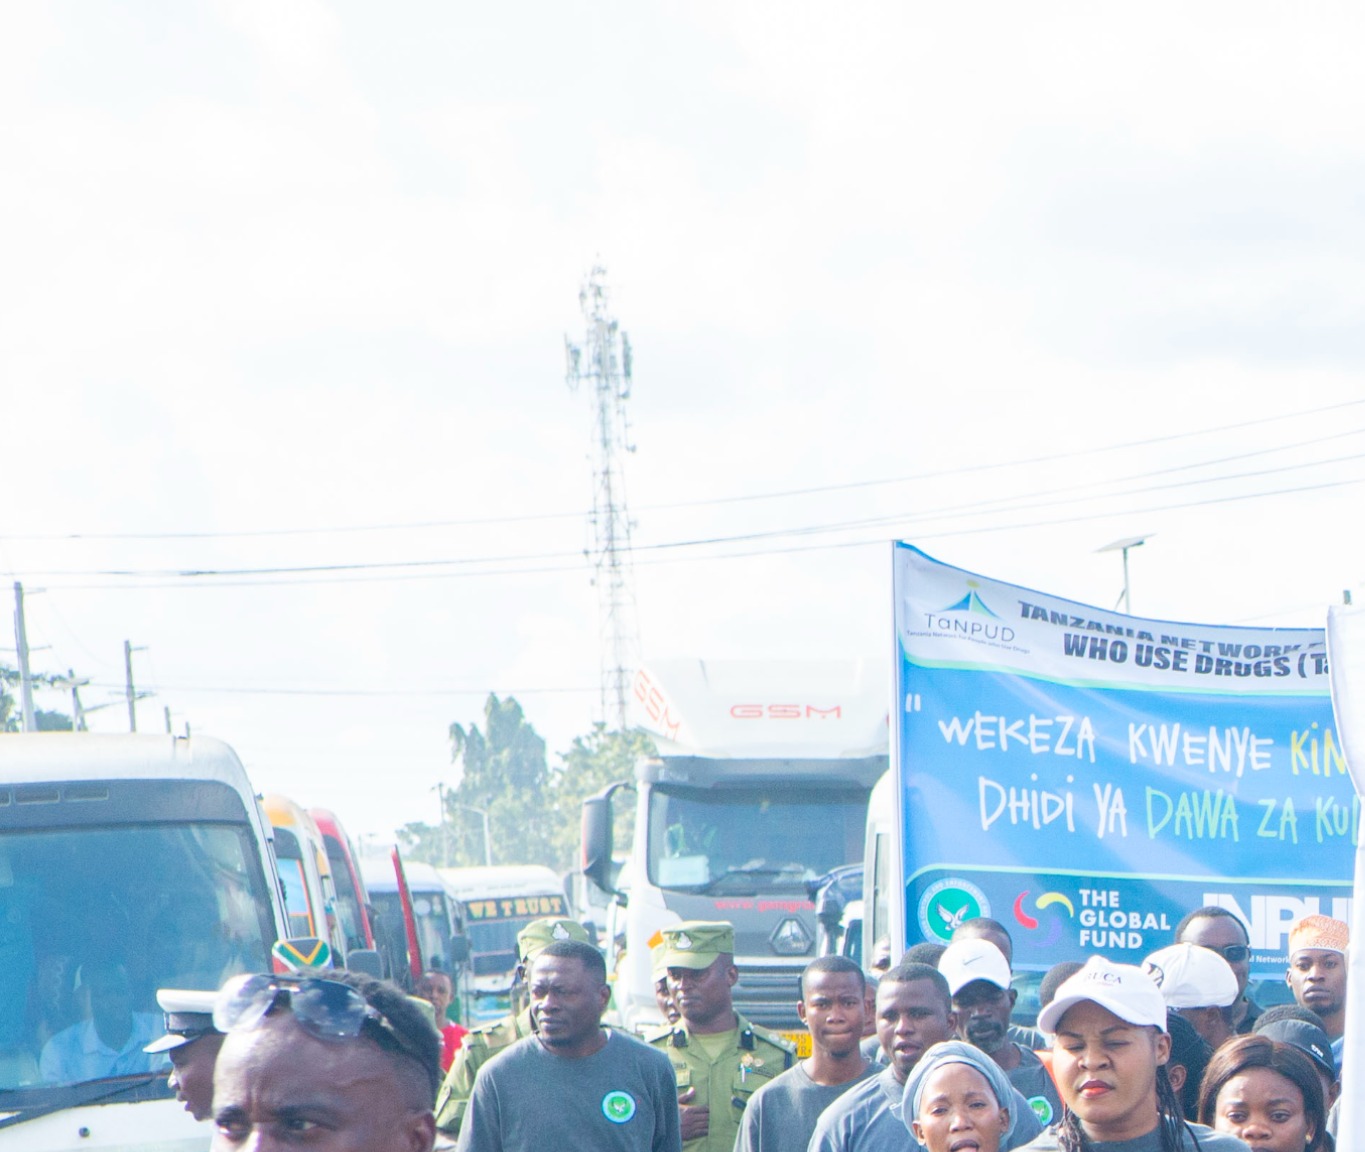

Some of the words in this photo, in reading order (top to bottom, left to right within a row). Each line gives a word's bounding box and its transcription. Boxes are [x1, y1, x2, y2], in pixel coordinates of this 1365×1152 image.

[924, 612, 1016, 642] TaNPUD
[1018, 600, 1154, 642] TANZANIA
[1161, 635, 1302, 659] NETWORK
[1063, 632, 1128, 664] WHO
[1134, 643, 1188, 672] USE
[1195, 654, 1291, 678] DRUGS
[633, 669, 680, 742] GSM
[730, 704, 841, 719] GSM
[938, 710, 1095, 763] WEKEZA
[1129, 722, 1274, 777] KWENYE
[1093, 782, 1127, 839] YA
[1145, 786, 1239, 842] DAWA
[1257, 796, 1297, 844] ZA
[1079, 889, 1120, 908] THE
[1079, 909, 1171, 931] GLOBAL
[1079, 930, 1142, 950] FUND
